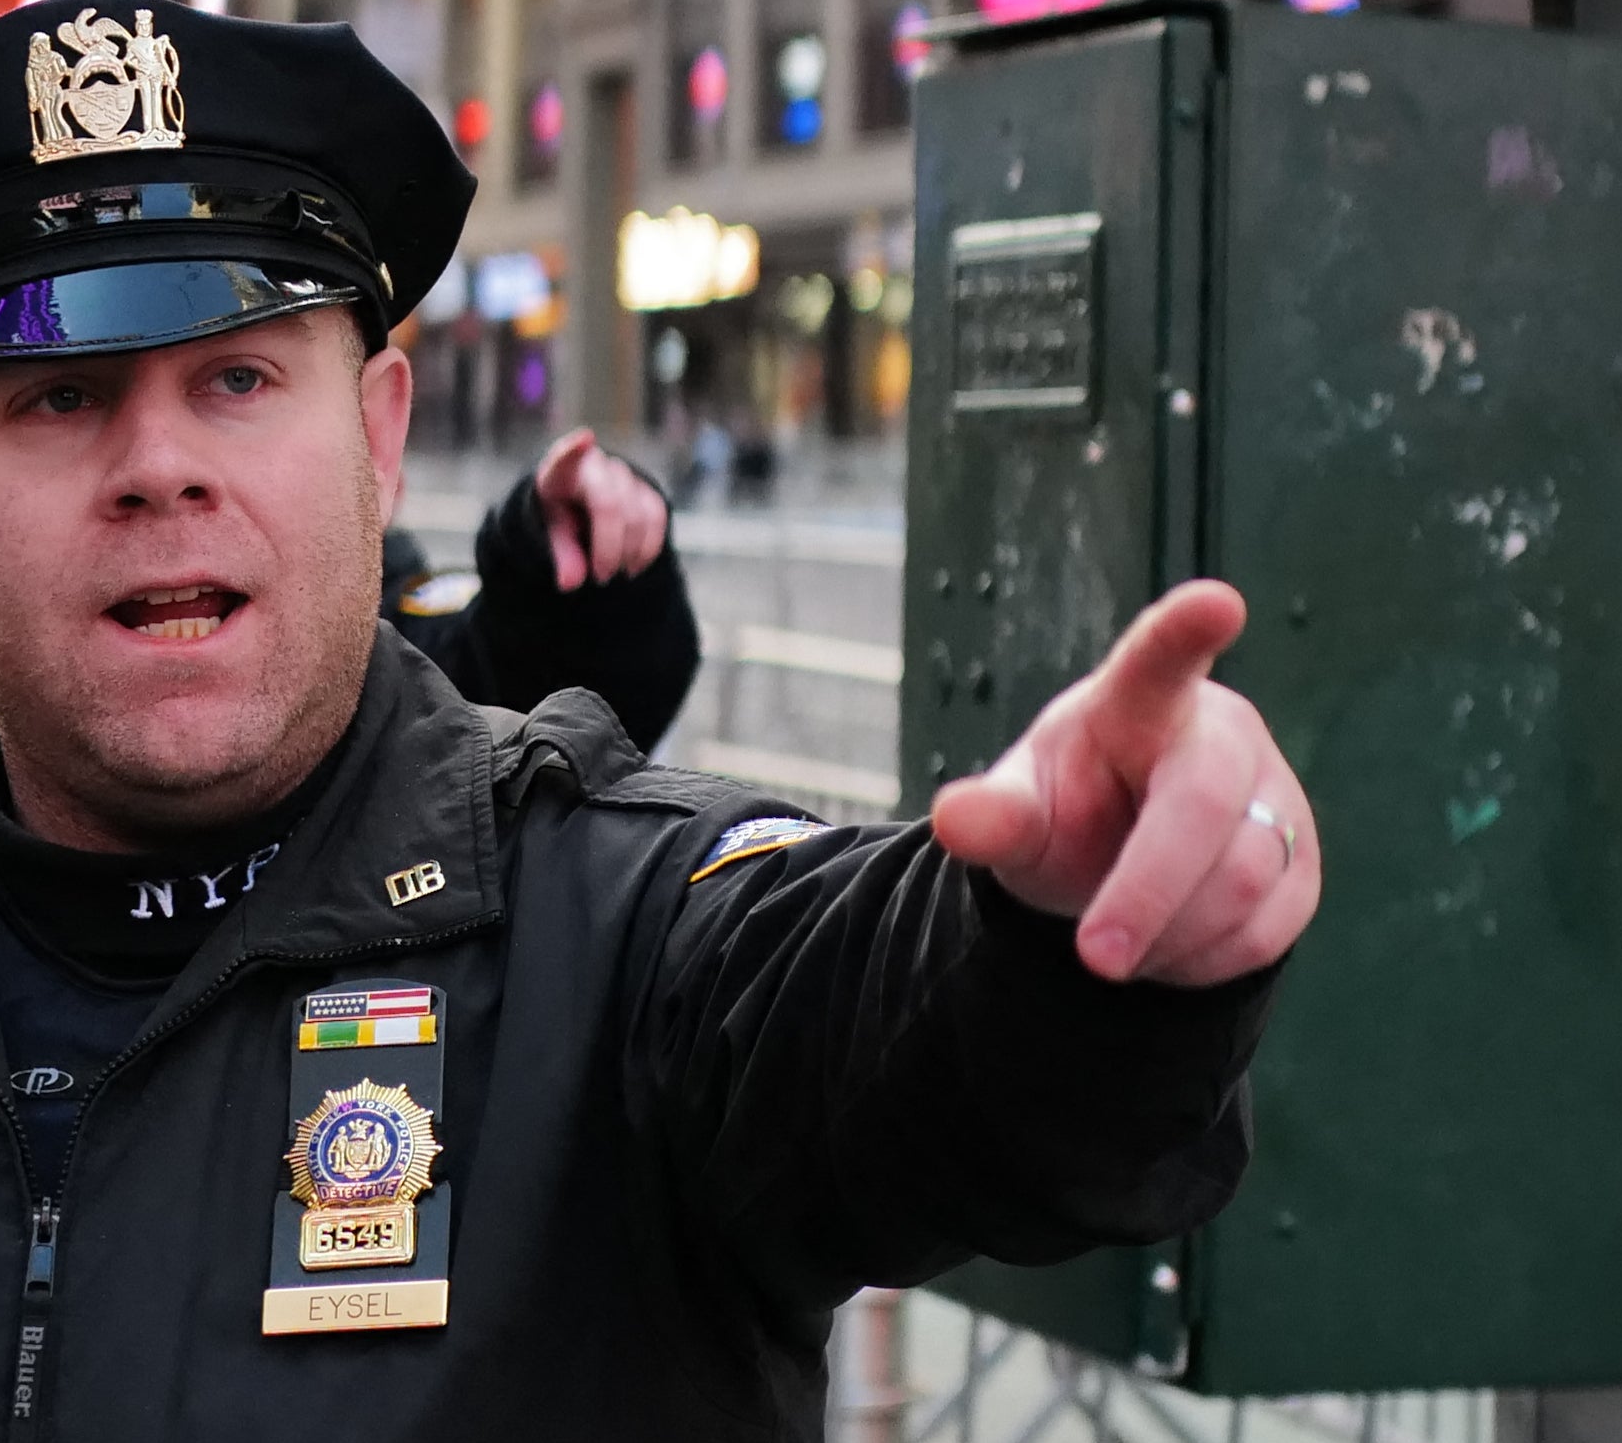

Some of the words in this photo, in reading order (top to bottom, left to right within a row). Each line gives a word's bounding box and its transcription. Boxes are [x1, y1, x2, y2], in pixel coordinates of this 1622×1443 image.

[324, 1101, 354, 1125] NEW
[357, 1100, 395, 1118] YORK
[395, 1118, 412, 1173] POLICE
[319, 1182, 395, 1200] DETECTIVE
[308, 1291, 403, 1322] EYSEL
